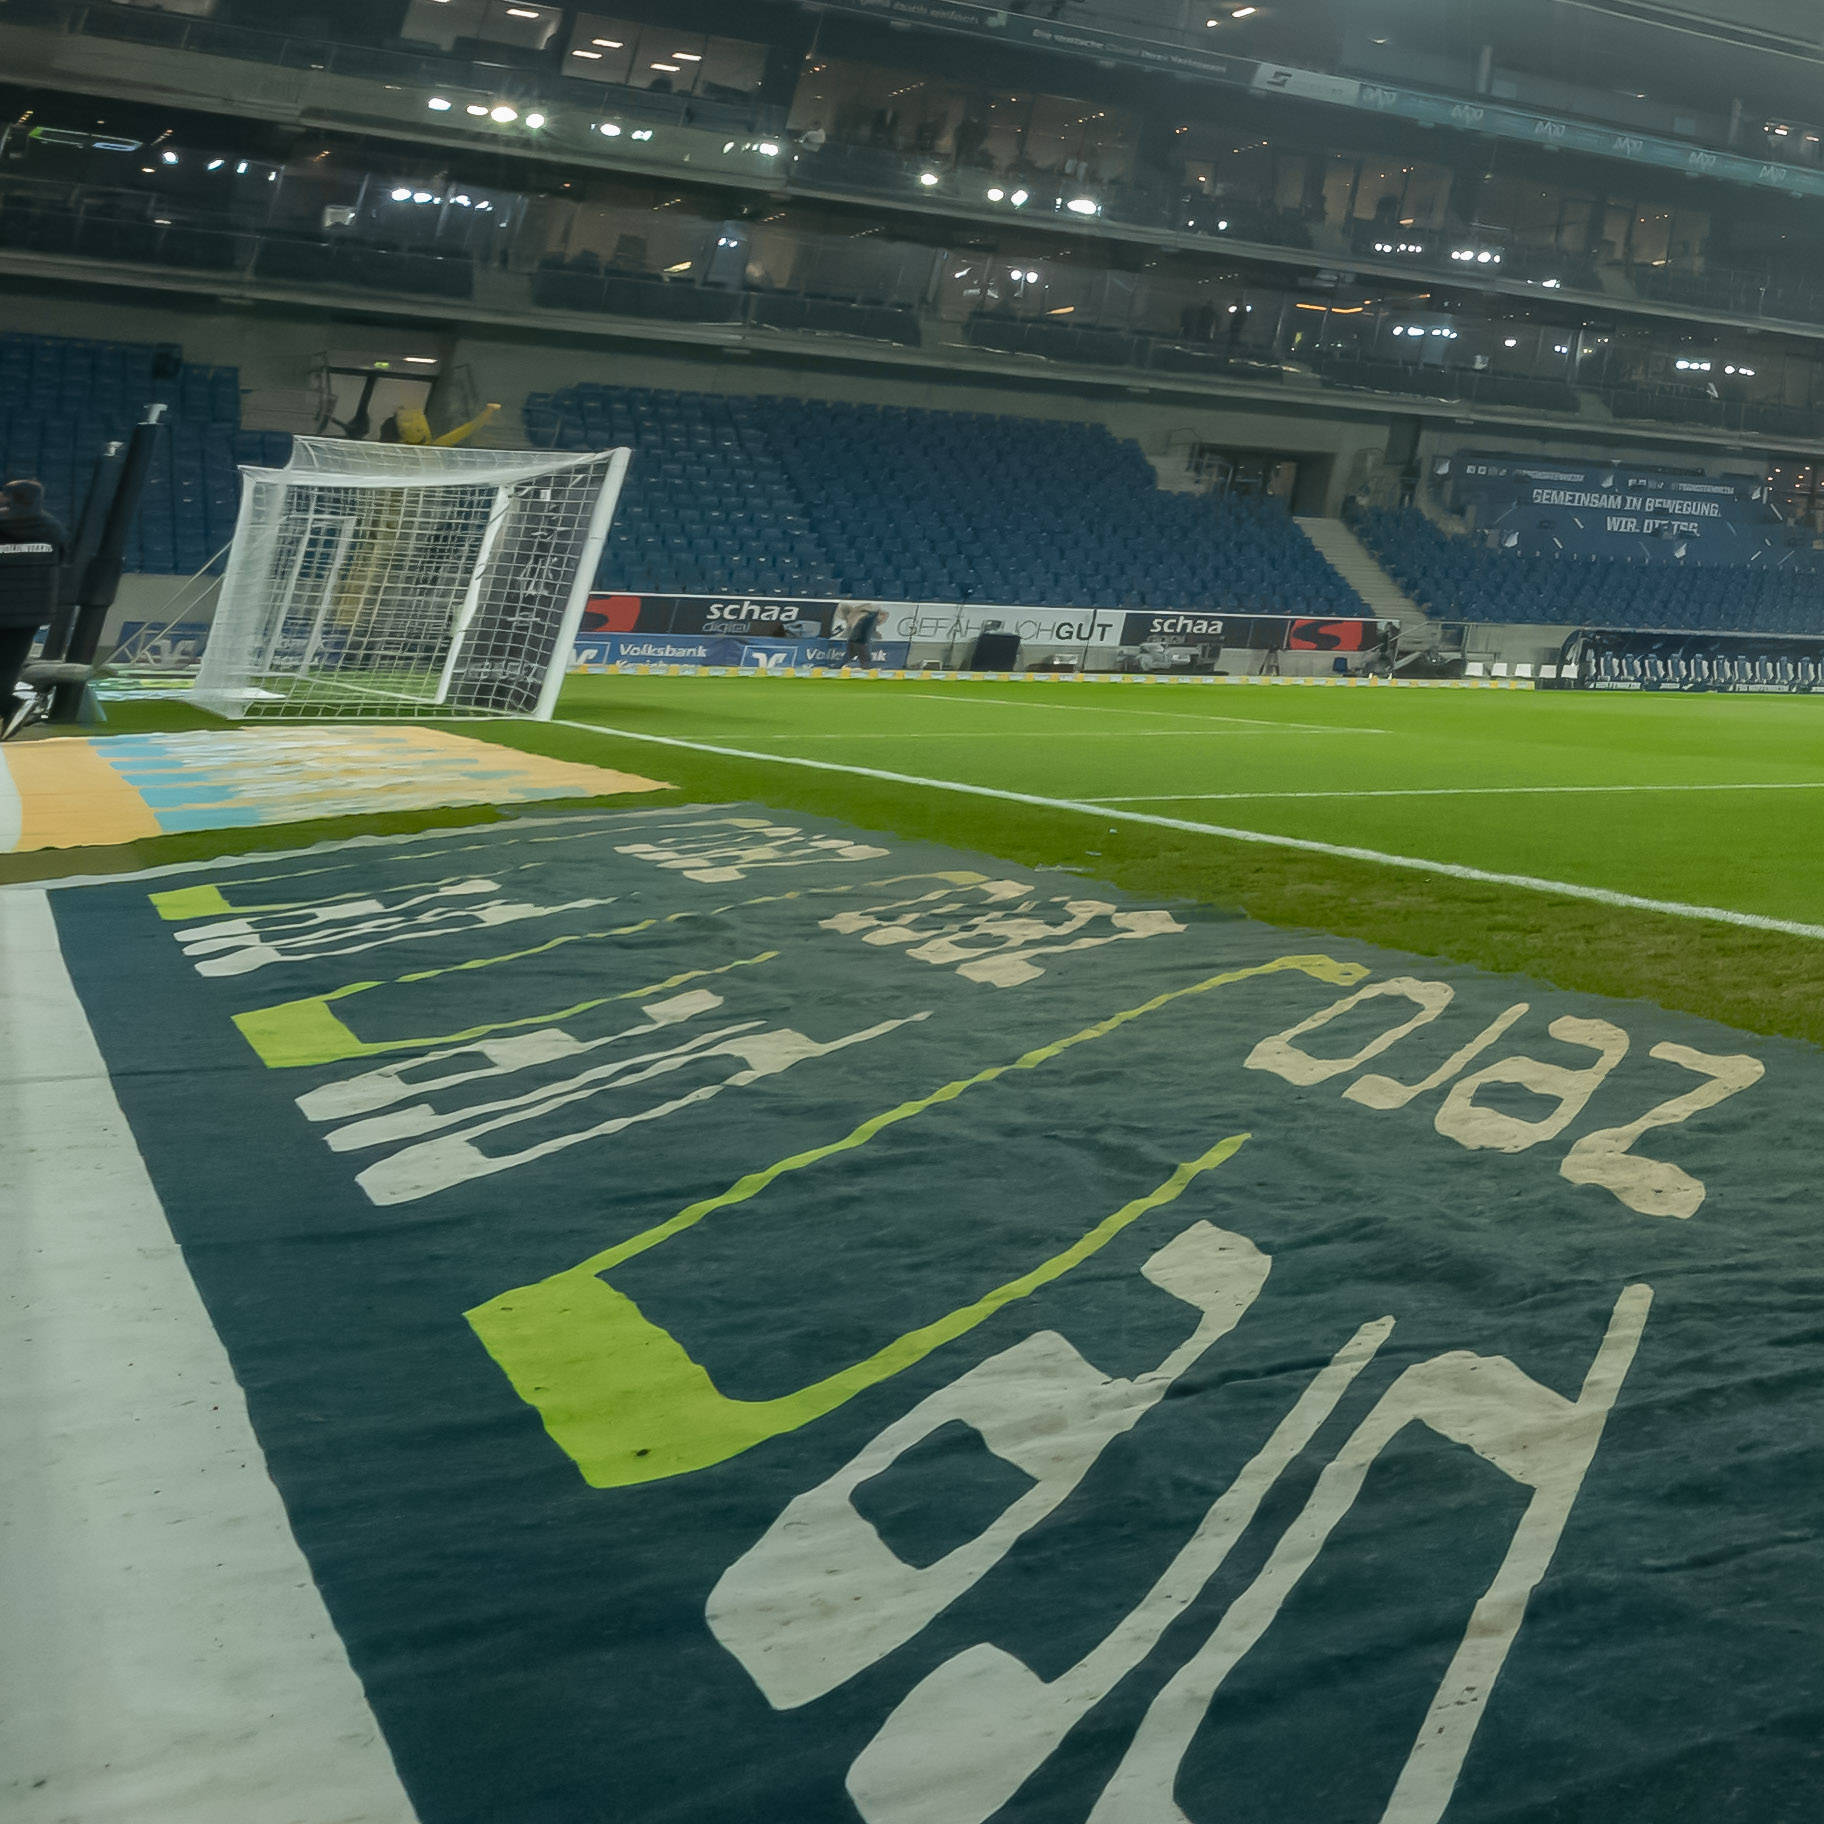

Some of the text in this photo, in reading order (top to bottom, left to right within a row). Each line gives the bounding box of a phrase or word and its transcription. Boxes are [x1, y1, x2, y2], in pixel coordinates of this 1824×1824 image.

[1532, 488, 1622, 511] GEMEINSAM
[1623, 496, 1642, 512] IN
[706, 600, 800, 622] schaa
[1149, 615, 1224, 635] schaa
[619, 642, 708, 658] Volksbank
